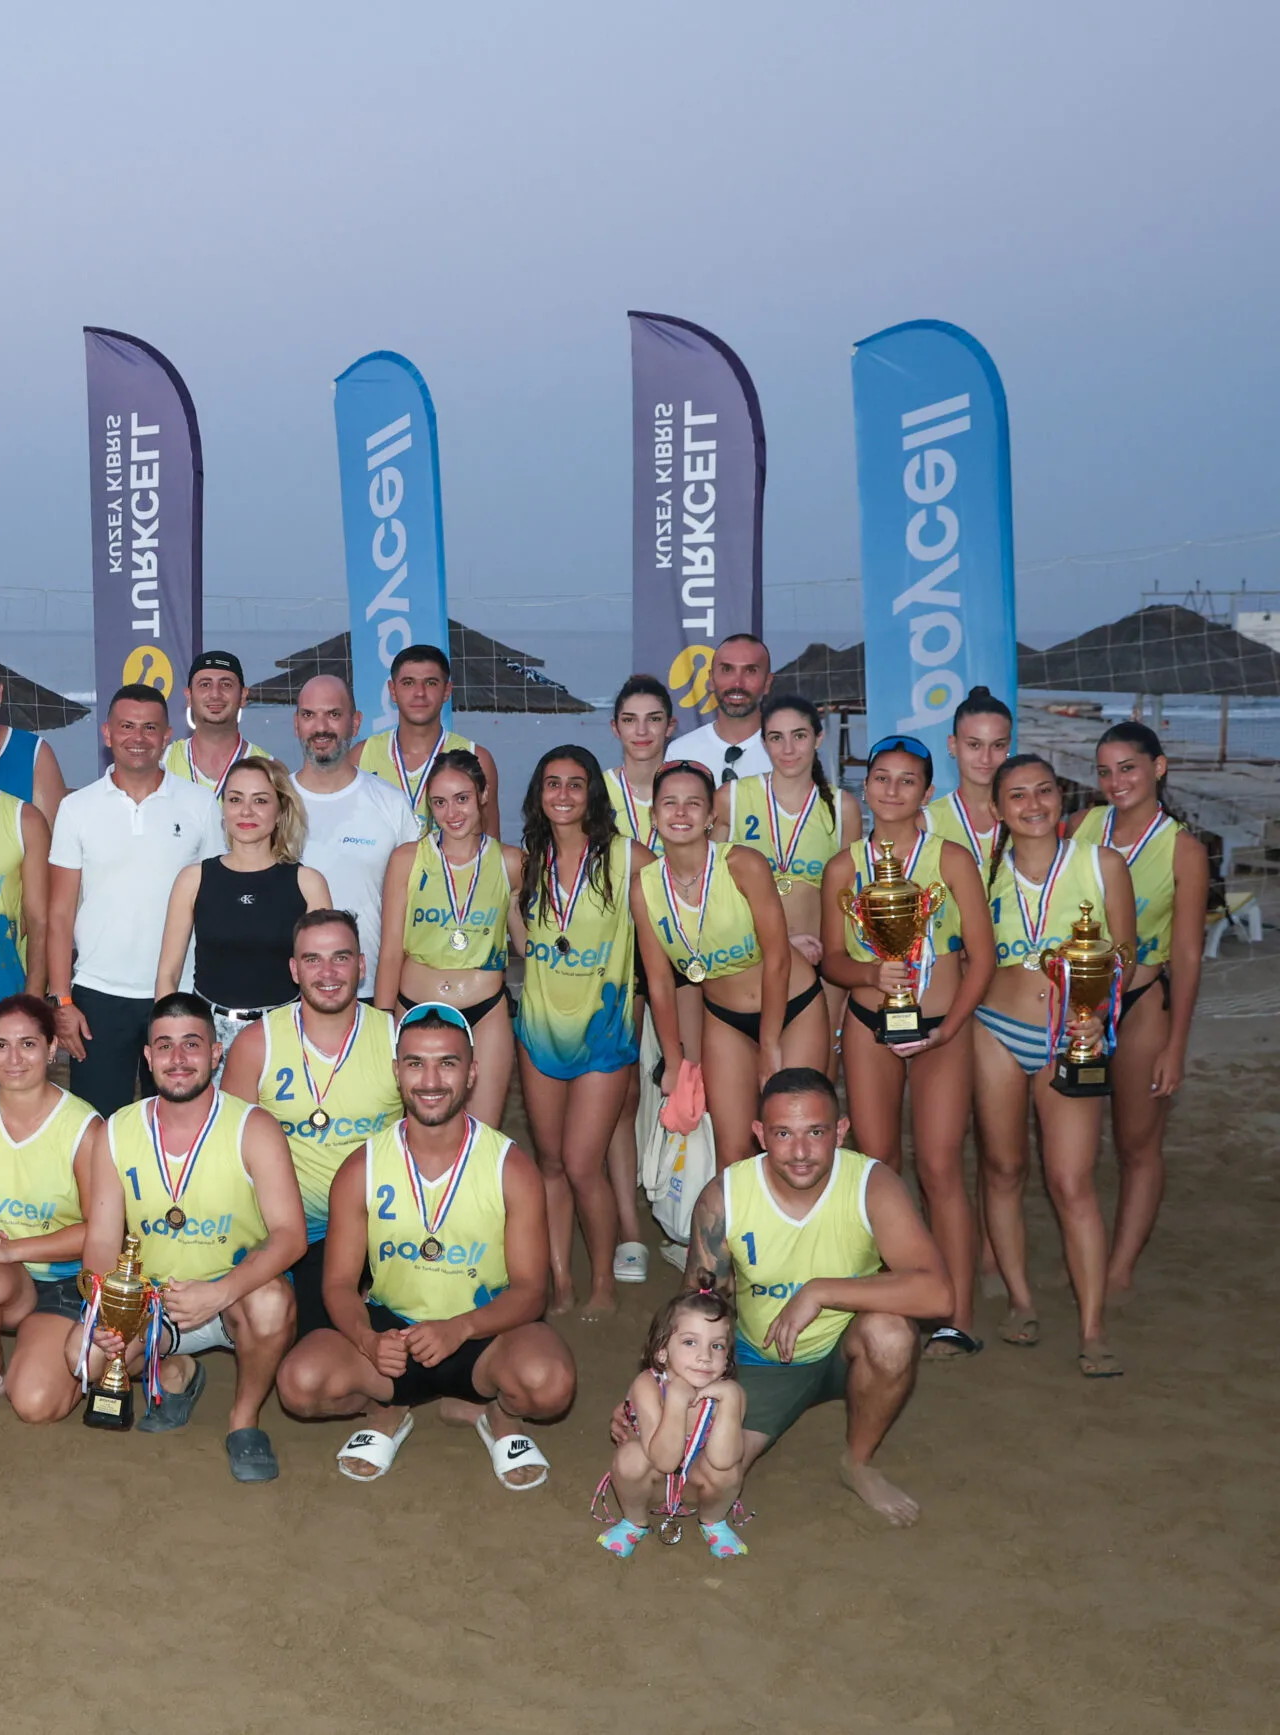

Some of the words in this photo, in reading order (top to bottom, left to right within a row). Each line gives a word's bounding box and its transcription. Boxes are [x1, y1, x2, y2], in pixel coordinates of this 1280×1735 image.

[745, 814, 761, 841] 2
[412, 906, 499, 928] payell
[990, 897, 1002, 925] 1
[658, 916, 674, 945] 1
[275, 1067, 296, 1102] 2
[125, 1166, 142, 1201] 1
[376, 1184, 397, 1220] 2
[379, 1241, 488, 1267] paell
[741, 1231, 757, 1266] 1
[354, 1433, 375, 1443] NIKE
[510, 1439, 530, 1450] NIKE
